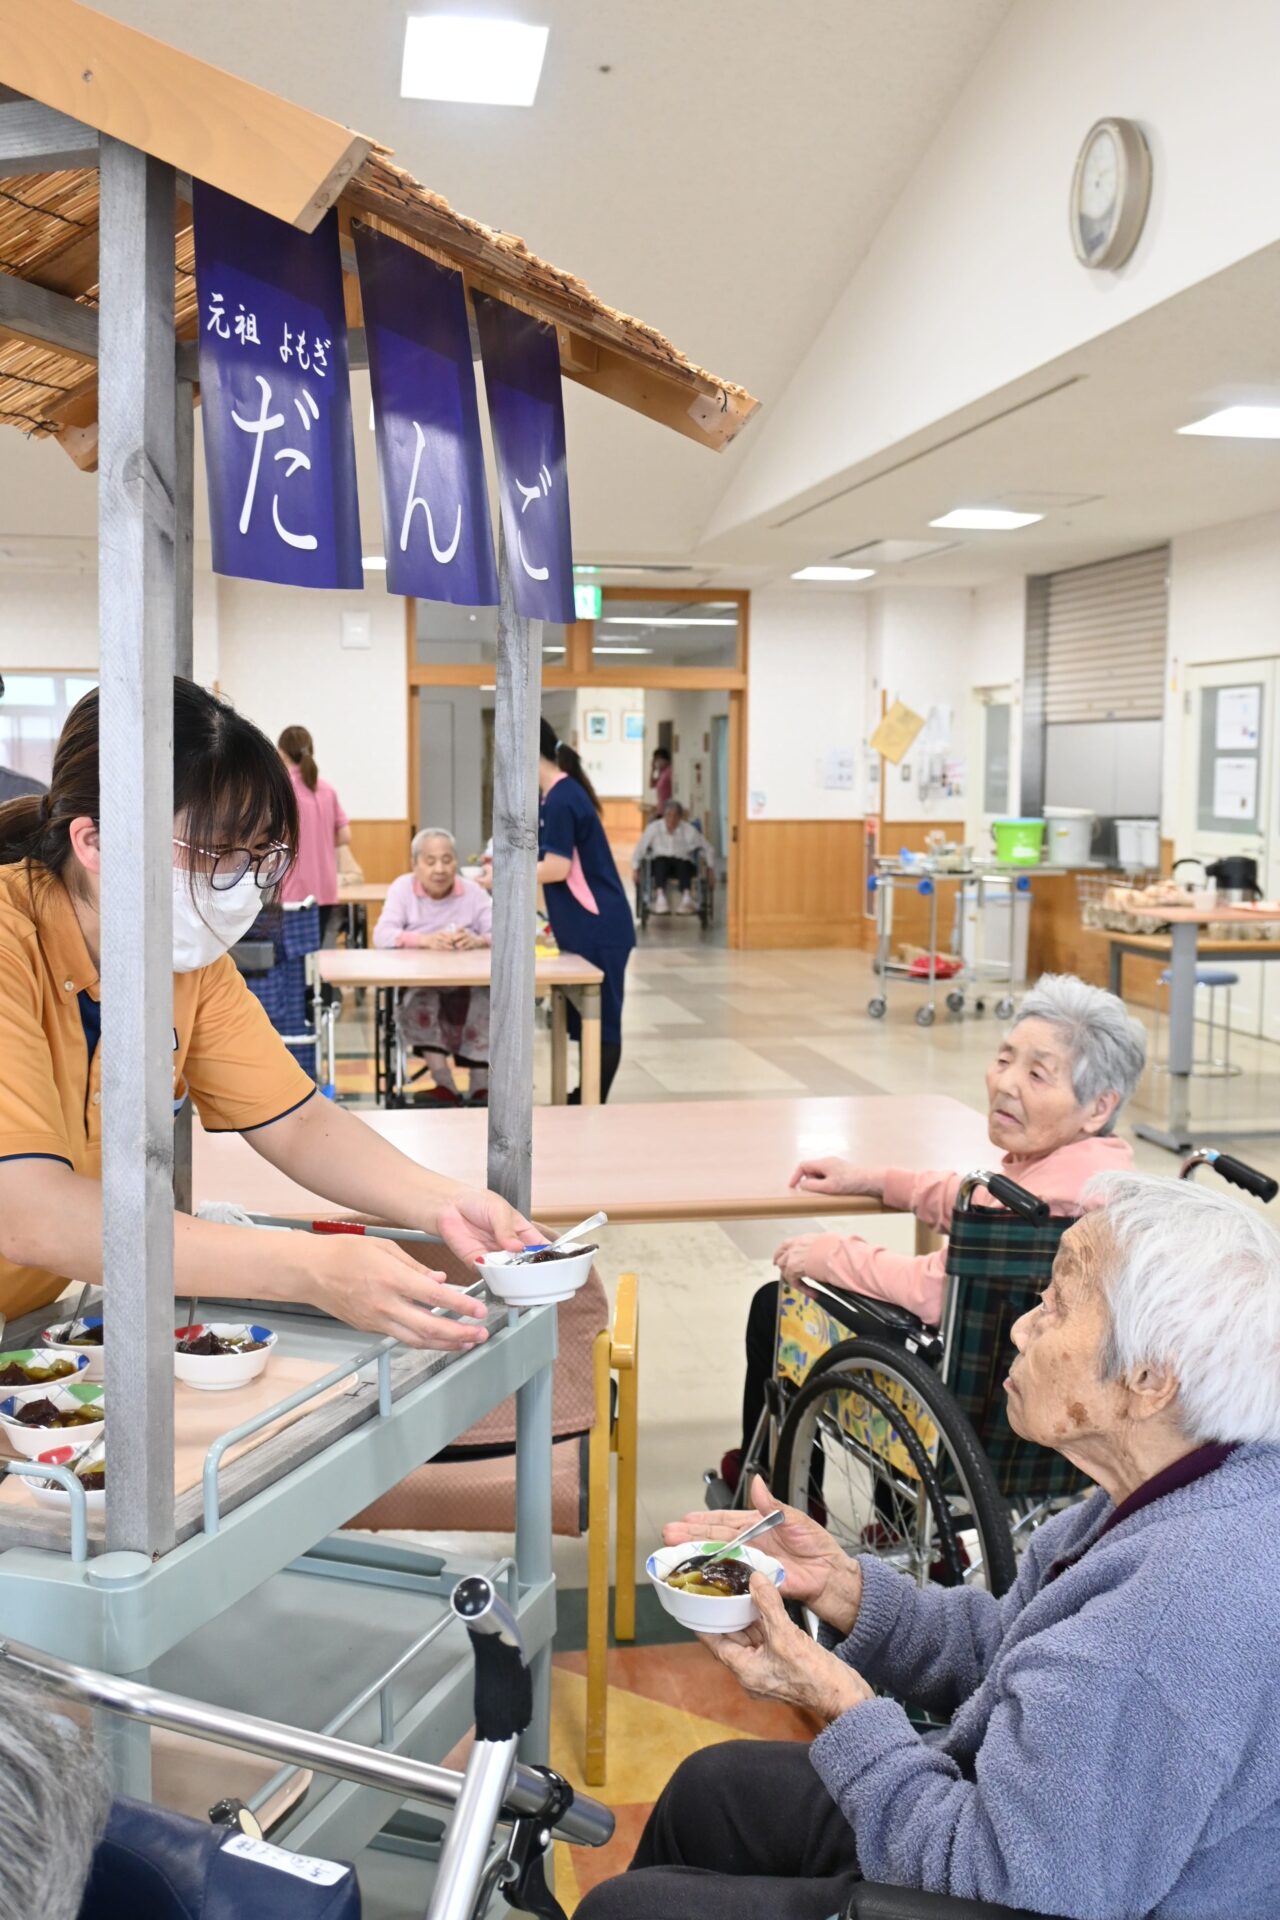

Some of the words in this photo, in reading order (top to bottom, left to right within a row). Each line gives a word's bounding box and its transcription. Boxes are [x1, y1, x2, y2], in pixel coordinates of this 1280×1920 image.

[206, 292, 261, 346] 元祖
[279, 322, 332, 377] よもぎ
[231, 375, 320, 550] だ
[400, 421, 462, 564] ん
[515, 464, 552, 581] ご
